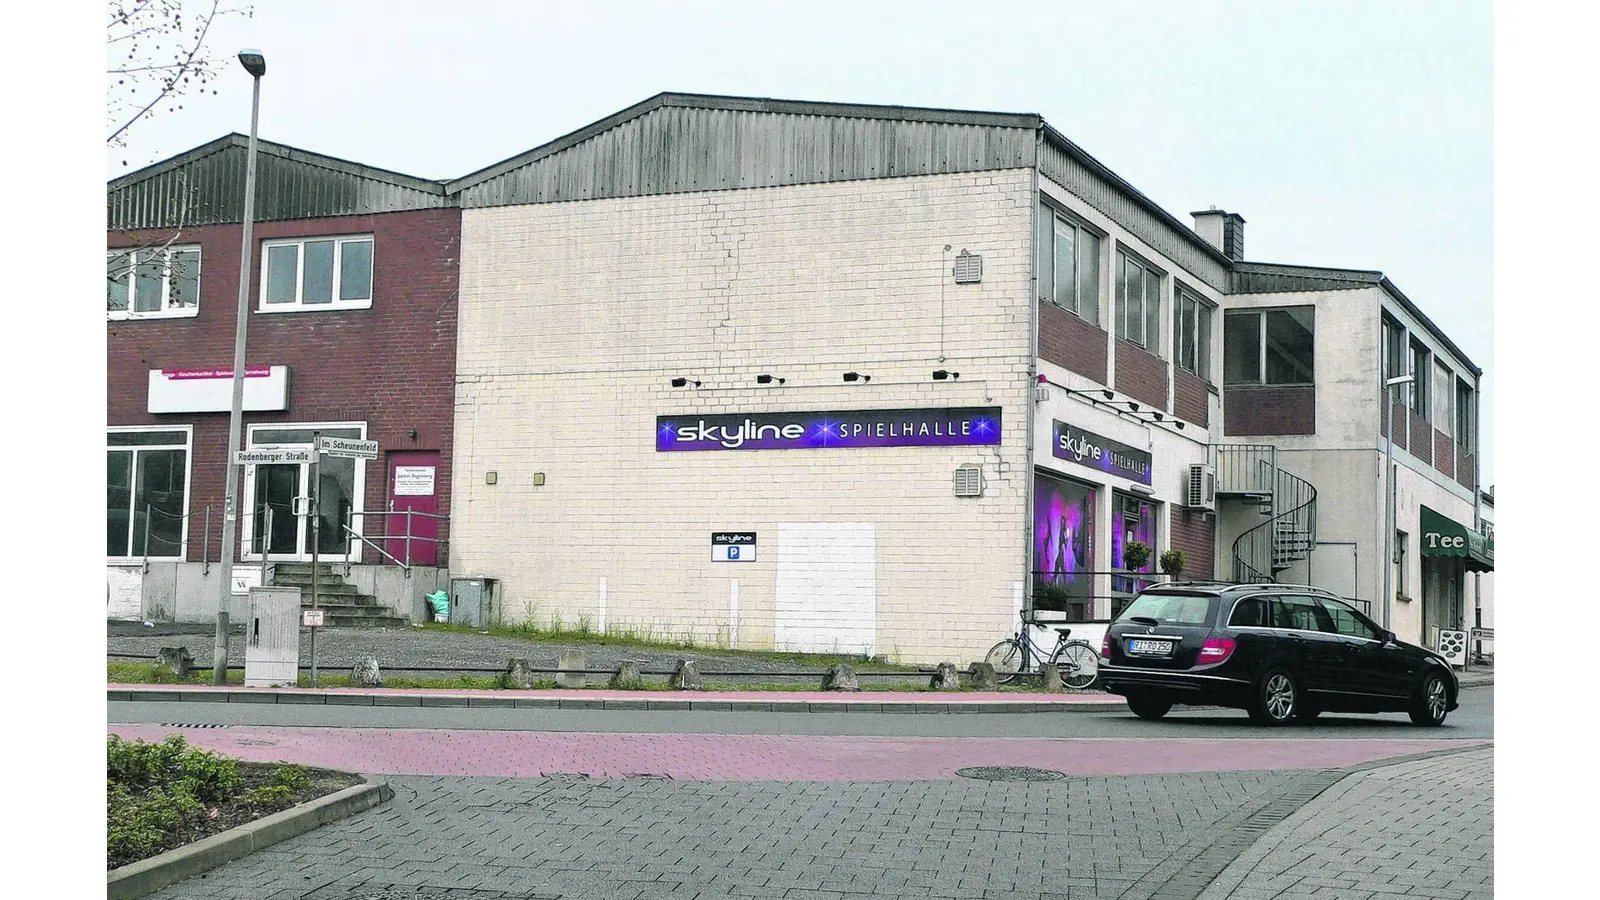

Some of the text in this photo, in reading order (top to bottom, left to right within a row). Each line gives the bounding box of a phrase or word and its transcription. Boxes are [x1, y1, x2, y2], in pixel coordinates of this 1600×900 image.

[676, 419, 971, 447] skyline SPIELHALLE
[321, 439, 377, 452] Im Scheunenfeld
[1059, 430, 1145, 475] skyline SPIELHALLE
[238, 452, 309, 462] Rodenberger Straße
[715, 534, 752, 543] skyline
[1424, 532, 1464, 548] Tee
